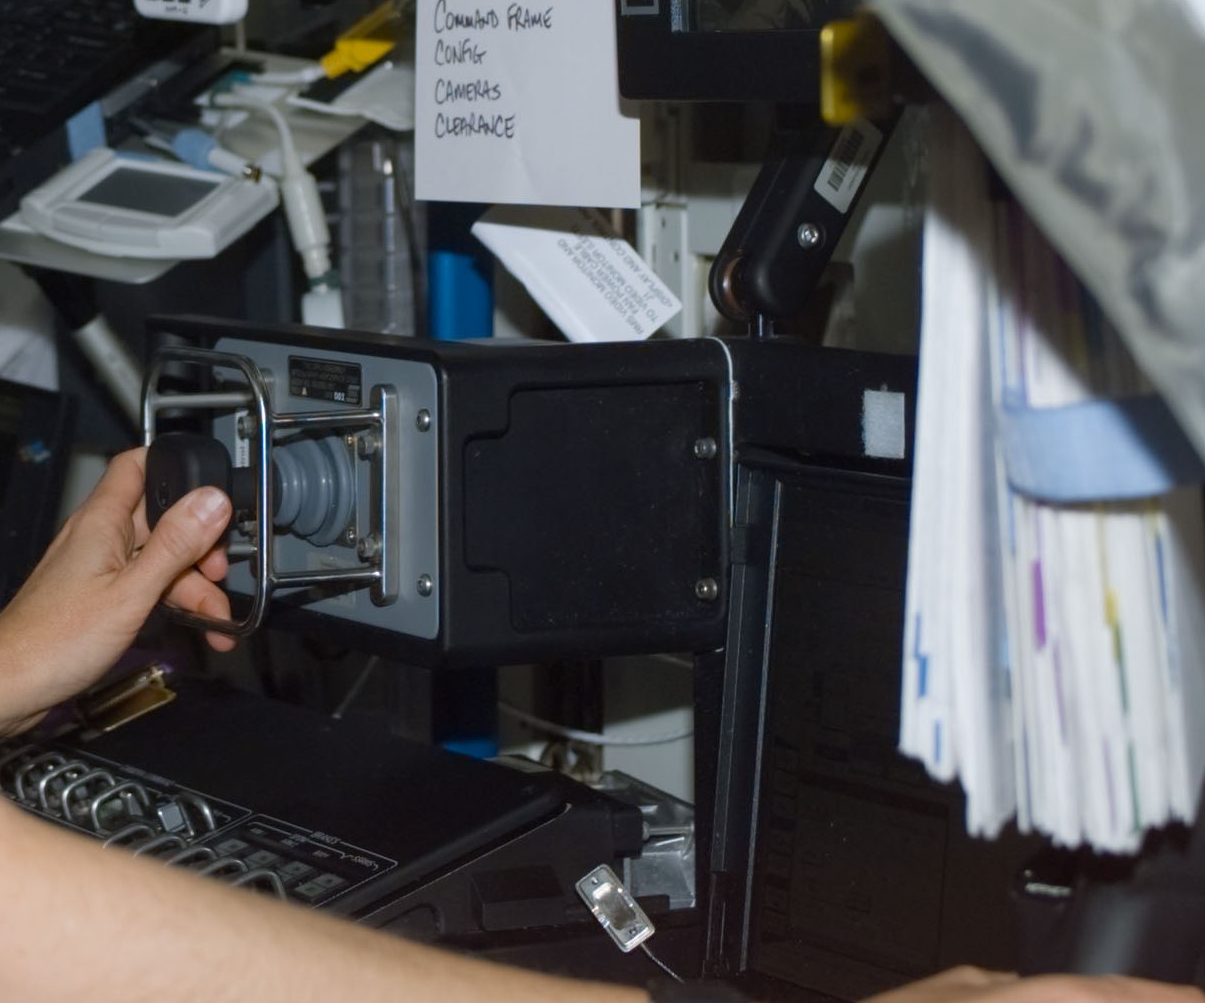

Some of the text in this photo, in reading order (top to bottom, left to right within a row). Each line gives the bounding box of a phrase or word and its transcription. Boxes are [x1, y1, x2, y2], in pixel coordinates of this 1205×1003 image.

[507, 2, 553, 32] FRAME
[434, 39, 487, 65] CONFIG
[435, 78, 501, 104] CAMERAS
[435, 113, 515, 138] CLEARANCE
[557, 237, 575, 257] AND
[573, 256, 606, 293] MONITOR
[593, 249, 626, 286] MONITOR
[597, 267, 625, 299] POWER
[605, 291, 628, 317] VIDEO
